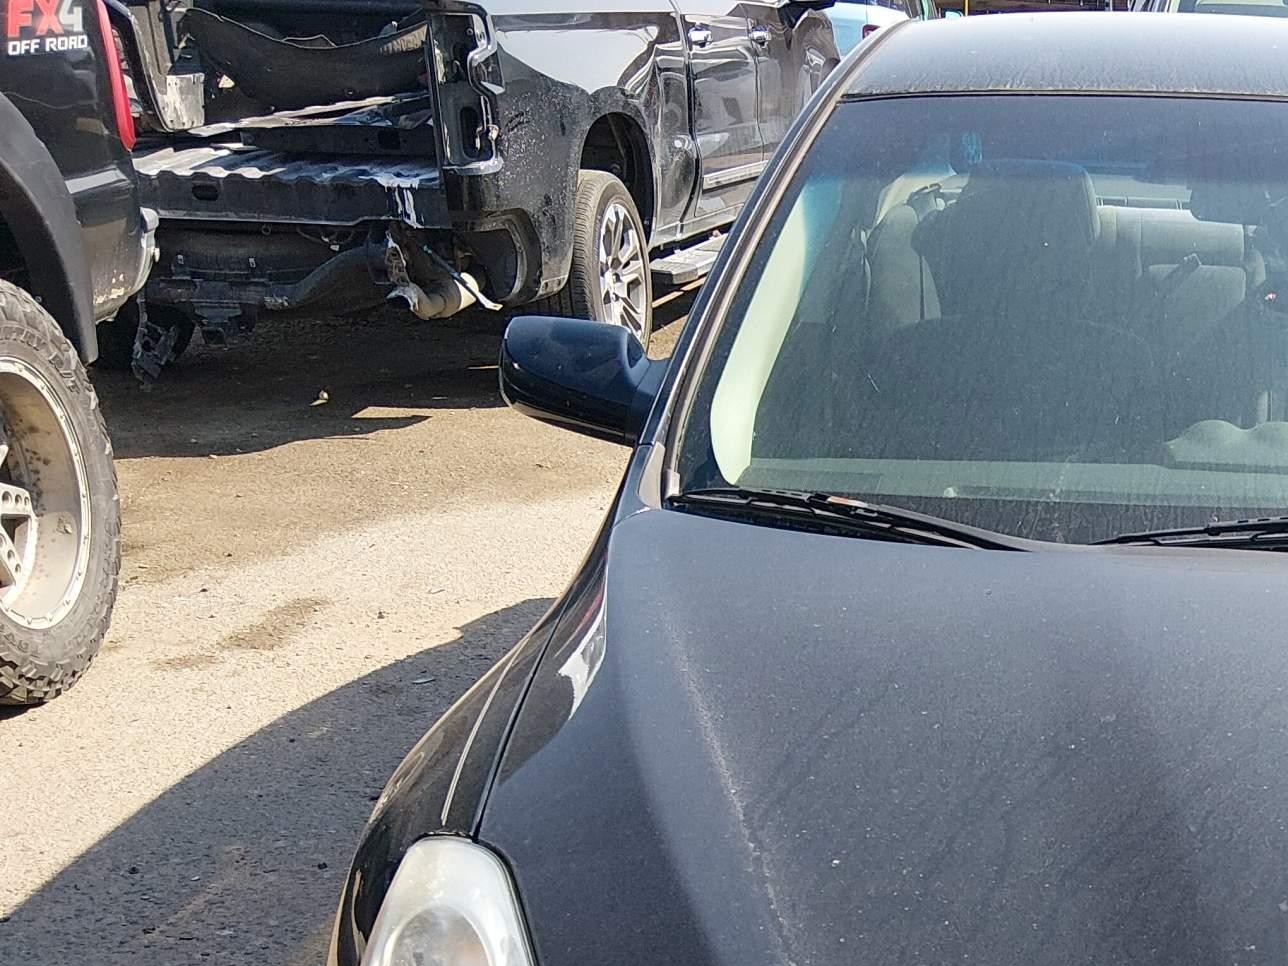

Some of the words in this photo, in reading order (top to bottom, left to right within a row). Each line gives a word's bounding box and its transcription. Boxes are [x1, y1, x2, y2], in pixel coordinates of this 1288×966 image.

[8, 0, 84, 38] FX4
[8, 38, 41, 56] OFF
[45, 34, 88, 52] ROAD
